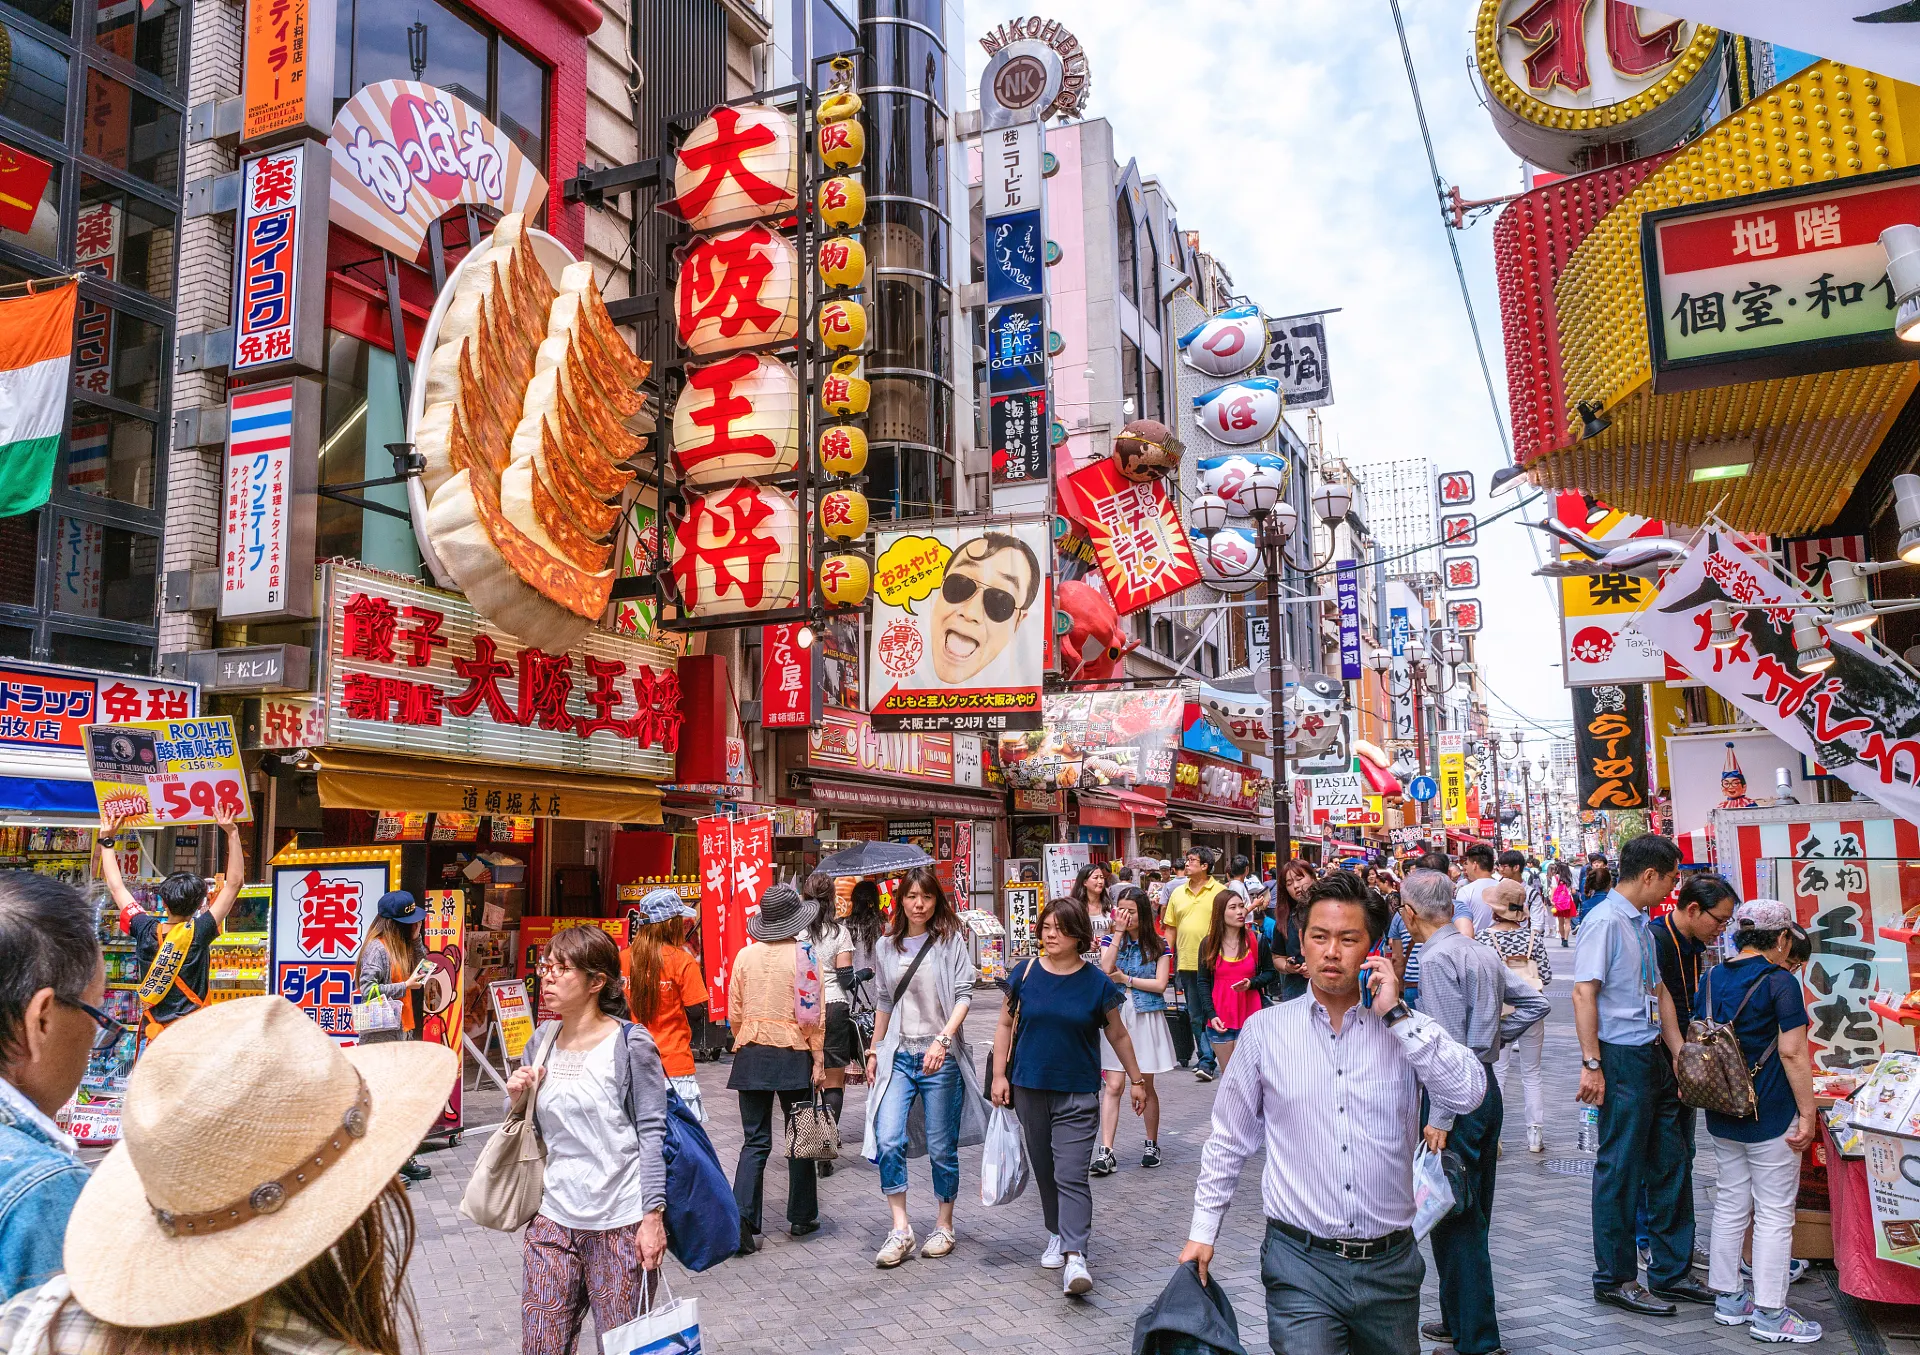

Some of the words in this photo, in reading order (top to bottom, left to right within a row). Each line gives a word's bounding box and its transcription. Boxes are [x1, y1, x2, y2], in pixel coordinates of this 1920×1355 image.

[291, 70, 304, 83] 2F
[979, 16, 1061, 57] NIKOH
[1056, 33, 1086, 109] BLDG
[1005, 69, 1035, 98] NK
[248, 103, 285, 119] RESTAURANT
[249, 155, 297, 210] 薬
[1732, 204, 1843, 258] 地階
[248, 216, 288, 331] ダイコク
[238, 329, 292, 366] 免税
[1002, 334, 1032, 349] BAR
[656, 104, 796, 613] 大阪王将
[991, 352, 1044, 369] OCEAN
[1266, 342, 1322, 386] 牛角
[1054, 428, 1062, 439] 2
[236, 465, 250, 590] タイカルチャースクール
[249, 453, 268, 572] クンテープ
[268, 459, 283, 588] タイ料理とタイスキの店
[1114, 488, 1169, 583] コナモン
[225, 551, 236, 592] 食材店
[880, 545, 939, 588] おみやげ
[268, 590, 279, 603] B1
[342, 592, 448, 669] 餃子
[221, 660, 278, 679] 平松ビル
[0, 682, 92, 718] ドラッグ
[101, 682, 188, 723] 免税
[341, 672, 445, 727] 専門店
[444, 633, 687, 754] 大阪王将
[886, 692, 1036, 709] よしもと芸人グッズ・大阪みやげ
[169, 721, 232, 741] ROIHI
[768, 712, 805, 725] 道頓堀店
[987, 716, 1006, 730] 선물
[155, 738, 234, 763] 酸痛贴布
[860, 722, 925, 775] GAME
[924, 748, 952, 765] NIKO-NIKO
[1587, 713, 1642, 807] らーめん
[1314, 775, 1359, 789] PASTA
[163, 779, 244, 820] 598
[460, 788, 562, 818] 道頓堀本店
[1316, 794, 1360, 807] PIZZA
[1348, 811, 1362, 821] 2F
[702, 833, 726, 857] 餃子
[1800, 865, 1863, 893] 名物
[301, 875, 360, 954] 薬
[425, 928, 457, 936] 213-0400
[157, 950, 184, 995] 中文导购
[528, 948, 535, 964] 1
[283, 966, 361, 1006] ダイコ
[507, 986, 517, 996] 2F
[526, 977, 535, 993] 2
